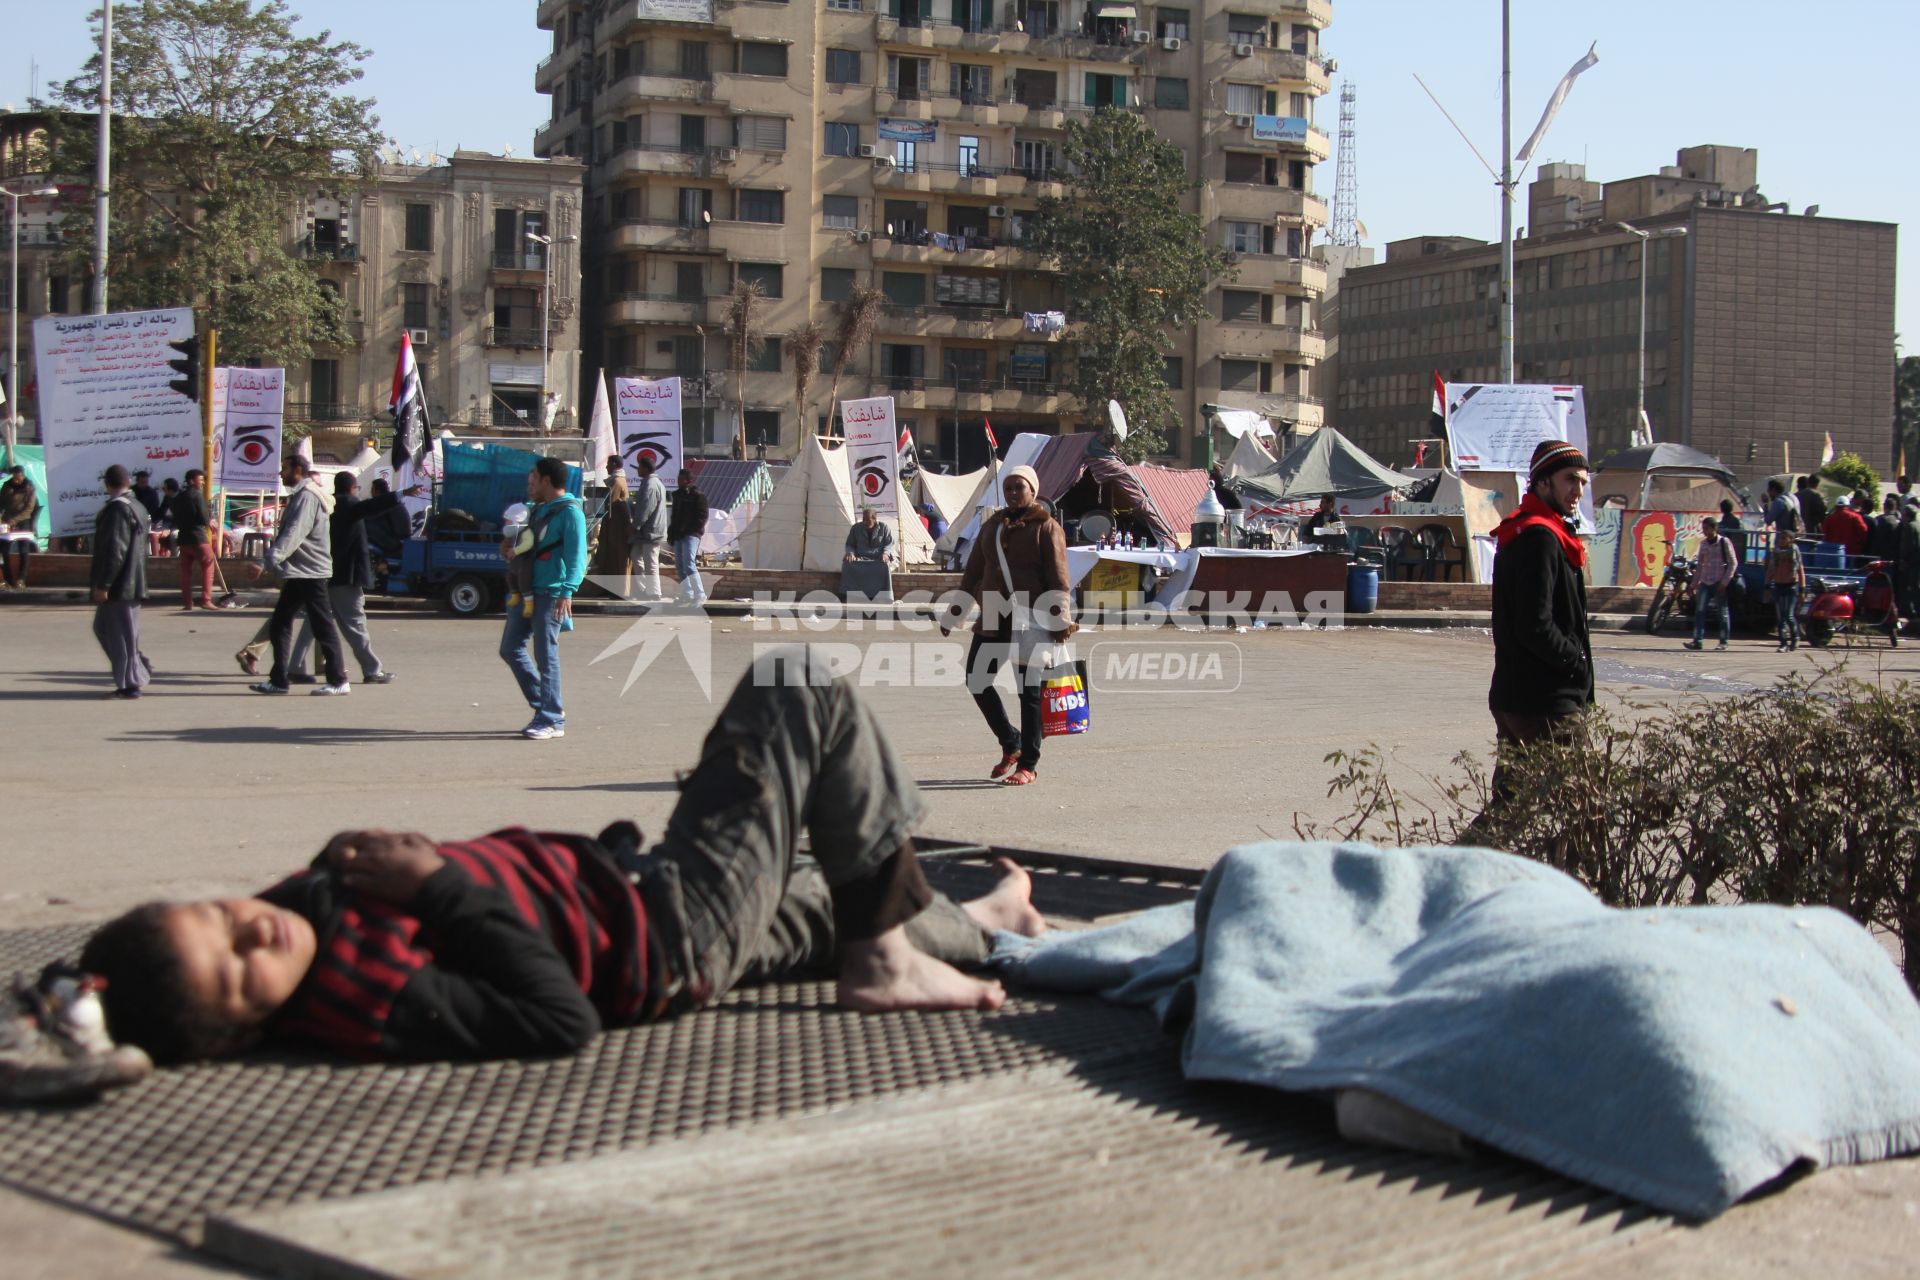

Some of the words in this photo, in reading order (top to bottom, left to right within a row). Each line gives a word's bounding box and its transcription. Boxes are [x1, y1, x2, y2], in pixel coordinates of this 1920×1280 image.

[54, 319, 102, 335] الجمهورية
[103, 318, 129, 330] رئيس
[618, 385, 673, 405] شايفنكم
[145, 446, 190, 462] ملحوظة
[1043, 688, 1060, 698] Our
[1050, 692, 1086, 713] KIDS
